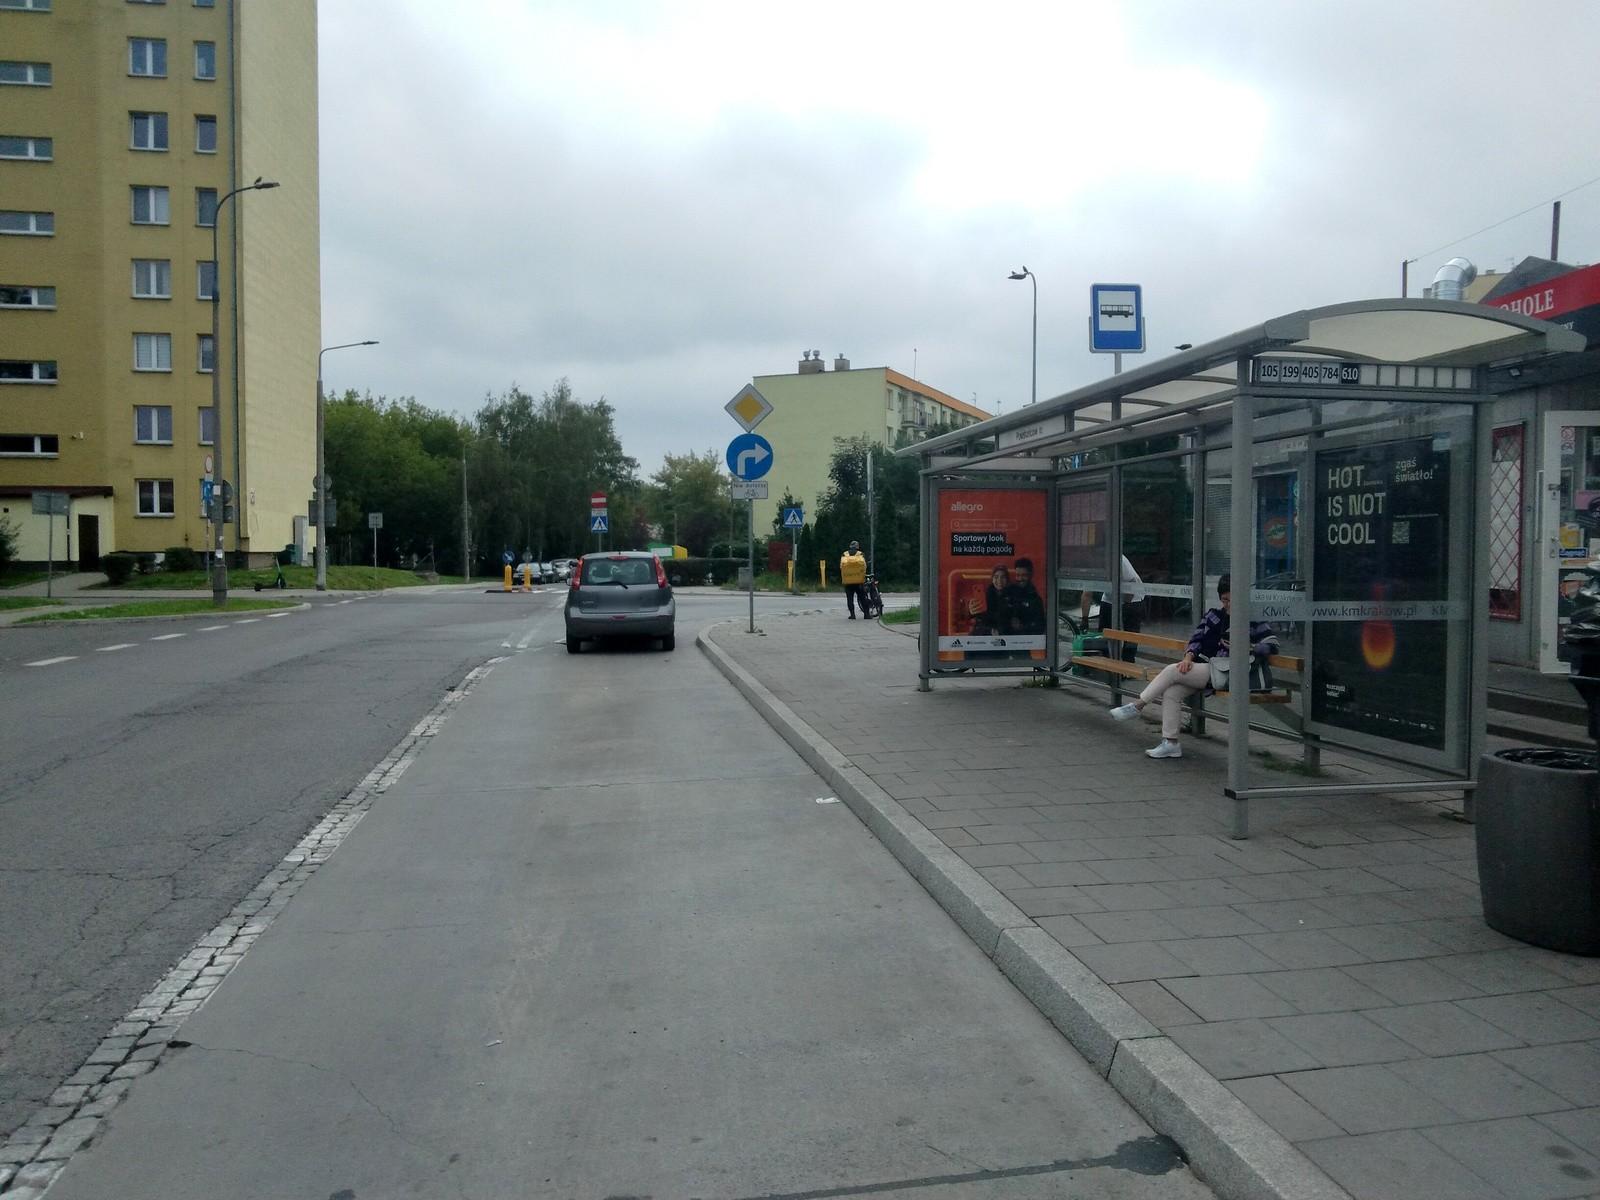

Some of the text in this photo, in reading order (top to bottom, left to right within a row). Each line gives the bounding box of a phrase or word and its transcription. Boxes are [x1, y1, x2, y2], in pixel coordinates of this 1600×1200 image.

[1261, 365, 1358, 380] 105 199 405 784 610
[1395, 456, 1417, 471] zgaś
[1328, 464, 1365, 489] HOT
[1395, 468, 1433, 483] światło!
[950, 501, 984, 513] allegro
[1327, 492, 1386, 517] IS NOT
[953, 534, 1004, 543] Sportowy look
[1327, 522, 1376, 545] COOL
[963, 545, 985, 554] każdą
[986, 545, 1013, 554] pogodę
[1262, 606, 1290, 617] KMK
